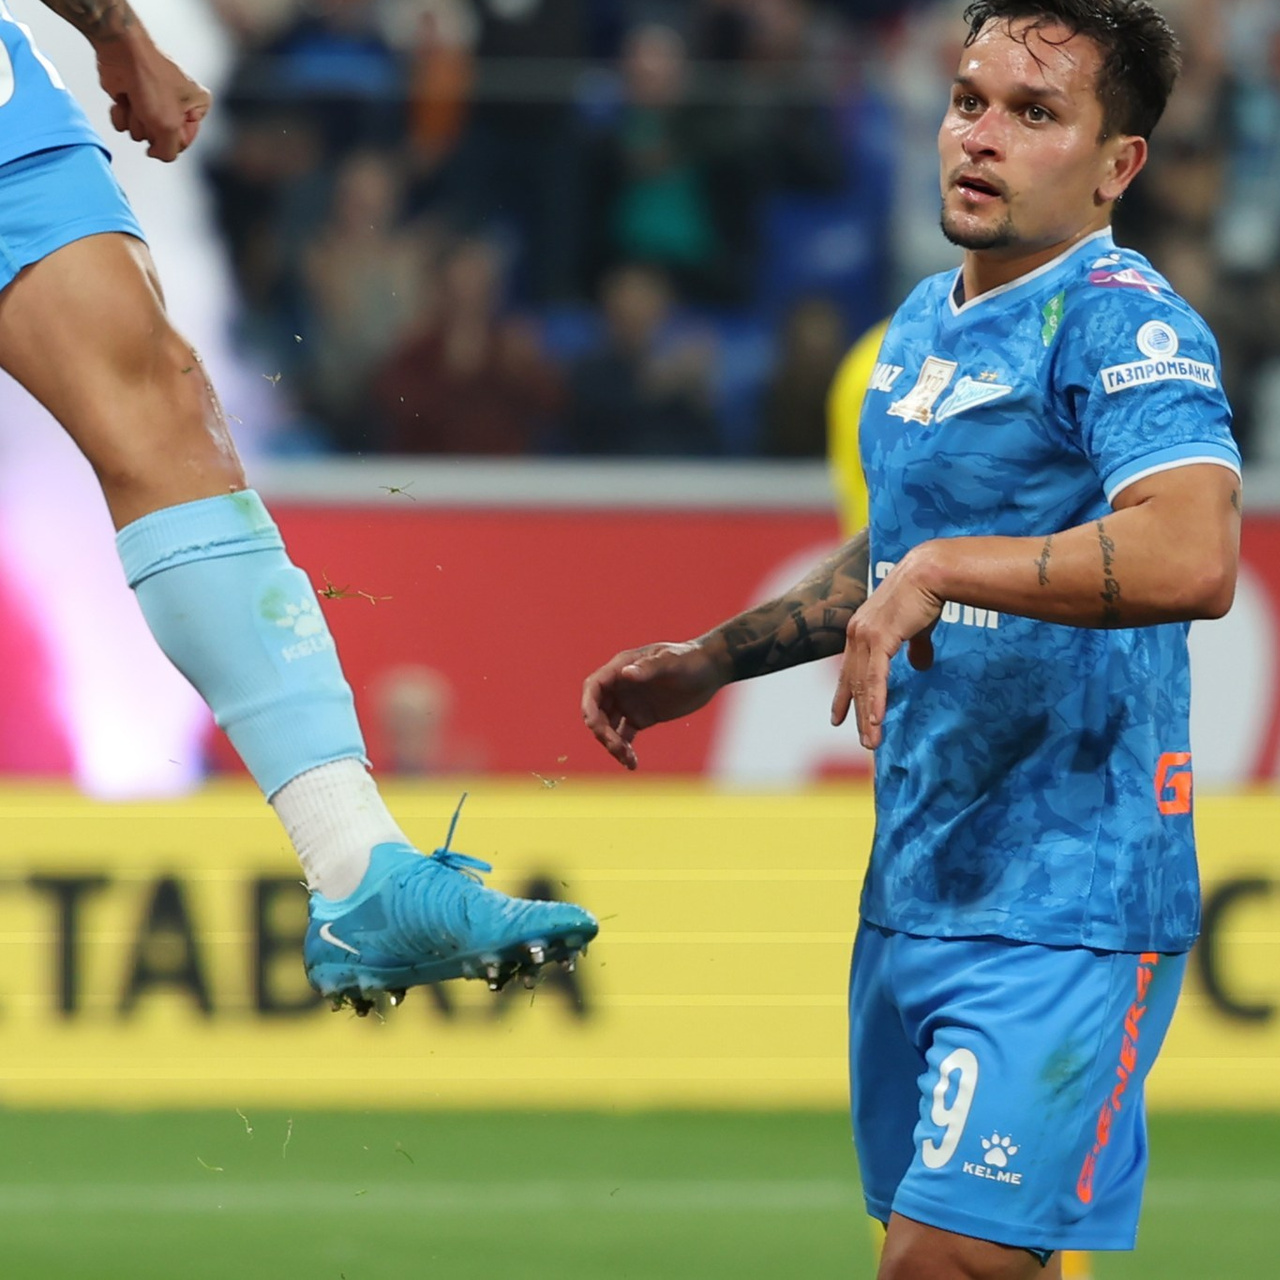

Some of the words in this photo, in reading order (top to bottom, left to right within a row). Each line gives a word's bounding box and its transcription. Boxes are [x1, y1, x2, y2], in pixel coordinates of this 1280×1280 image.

[1107, 360, 1212, 389] ГАЗПРОМБАНК
[922, 1048, 979, 1169] 9
[963, 1162, 1022, 1185] KELME
